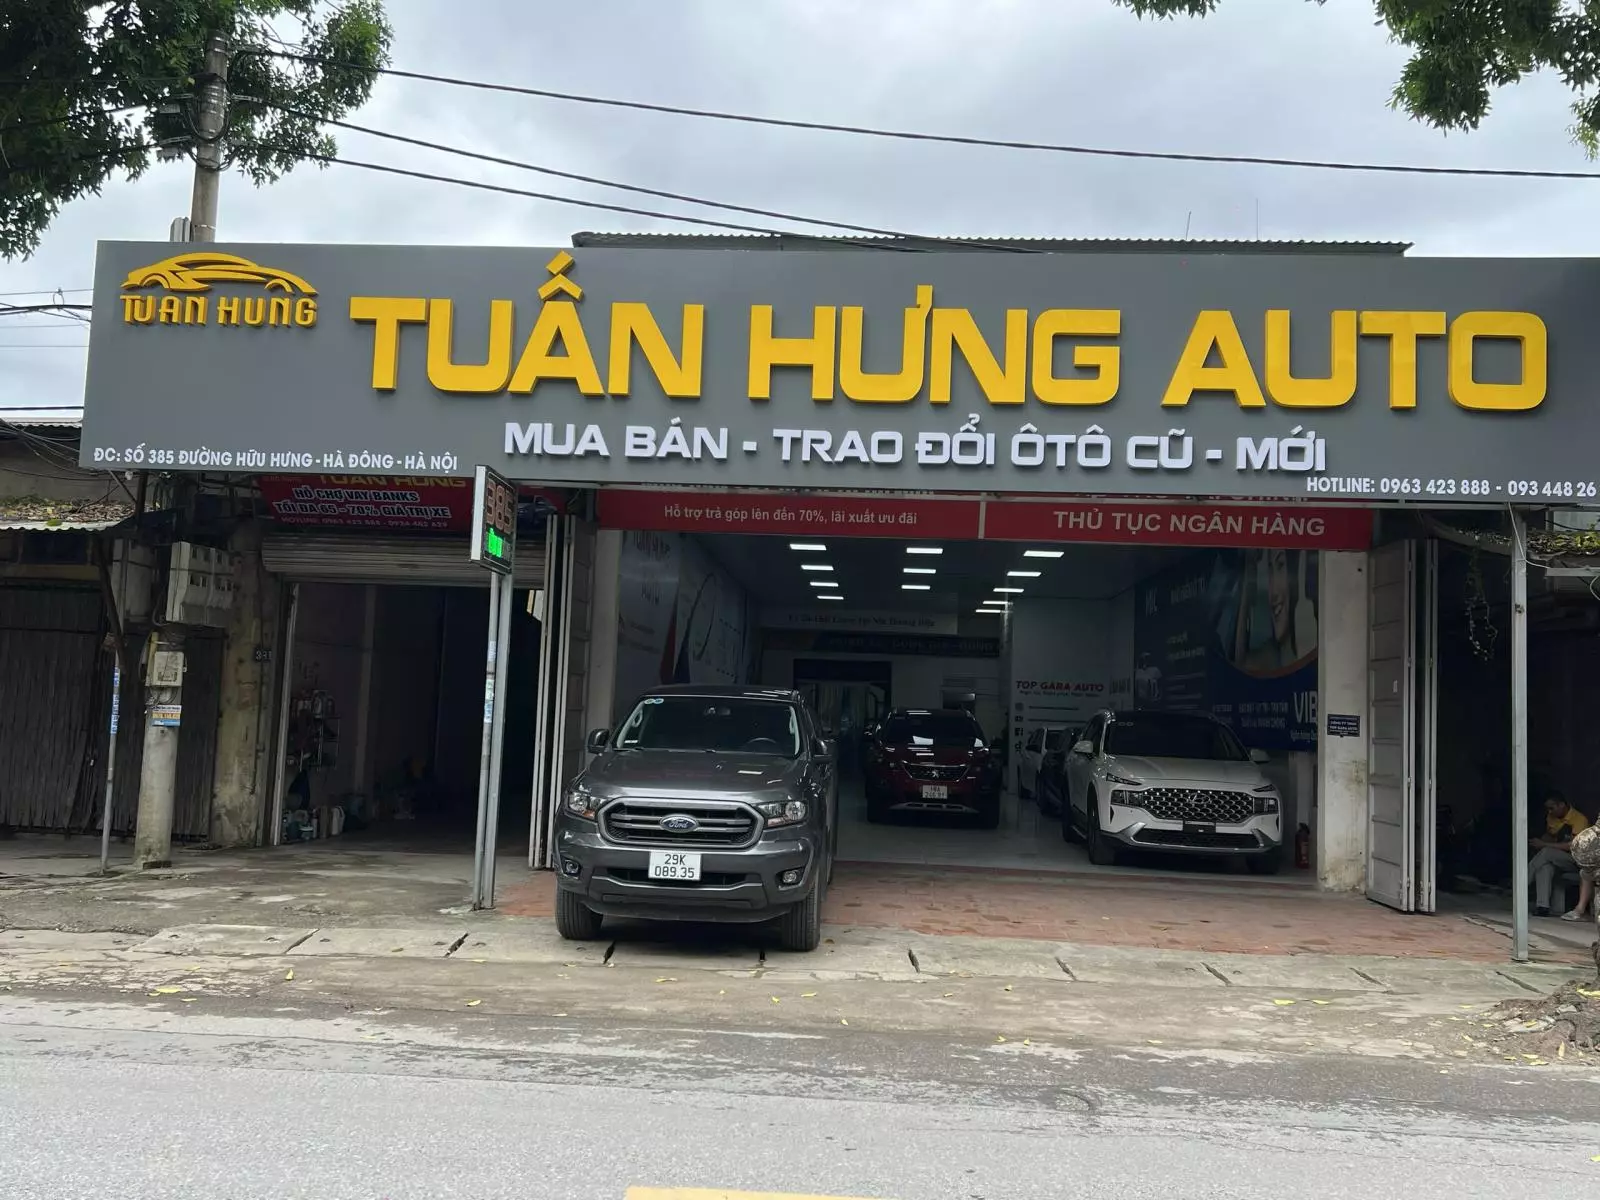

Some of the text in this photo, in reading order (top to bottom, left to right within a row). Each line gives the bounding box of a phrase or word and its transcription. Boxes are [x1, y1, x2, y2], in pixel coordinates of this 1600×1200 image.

[217, 296, 318, 328] HUNG
[350, 250, 1548, 411] TUẤN HƯNG AUTO
[504, 413, 1327, 472] MUA BÁN - TRAO ĐỔI ÔTÔ CŨ - MỚI
[94, 447, 121, 462] ĐC:
[124, 442, 146, 463] SỐ
[149, 450, 175, 464] 385
[178, 446, 233, 467] ĐƯỜNG
[236, 449, 266, 467] HỮU
[270, 451, 313, 468] HƯNG
[323, 450, 344, 468] HÀ
[348, 450, 394, 469] ĐÔNG
[404, 451, 426, 470] HÀ
[430, 452, 458, 474] NỘI
[345, 490, 371, 501] VAY
[372, 491, 420, 503] BANKS
[1306, 477, 1376, 493] HOTLINE:
[1380, 478, 1421, 494] 0963
[1425, 478, 1457, 495] 423
[1460, 479, 1491, 495] 888
[1507, 480, 1539, 497] 093
[1542, 481, 1573, 497] 448
[1576, 482, 1598, 498] 26
[273, 500, 297, 513] TỐI
[347, 504, 381, 516] 70%
[430, 506, 452, 518] XE
[664, 503, 917, 524] Hỗ trợ trả góp lên đến 70%, lãi xuất ưu đãi
[1054, 508, 1325, 536] THỦ TỤC NGÂN HÀNG
[1016, 680, 1037, 690] TOP
[1040, 681, 1070, 691] GARA
[1074, 682, 1104, 692] AUTO
[668, 818, 689, 829] Ford
[665, 854, 686, 865] 29K
[655, 866, 695, 878] 089.35
